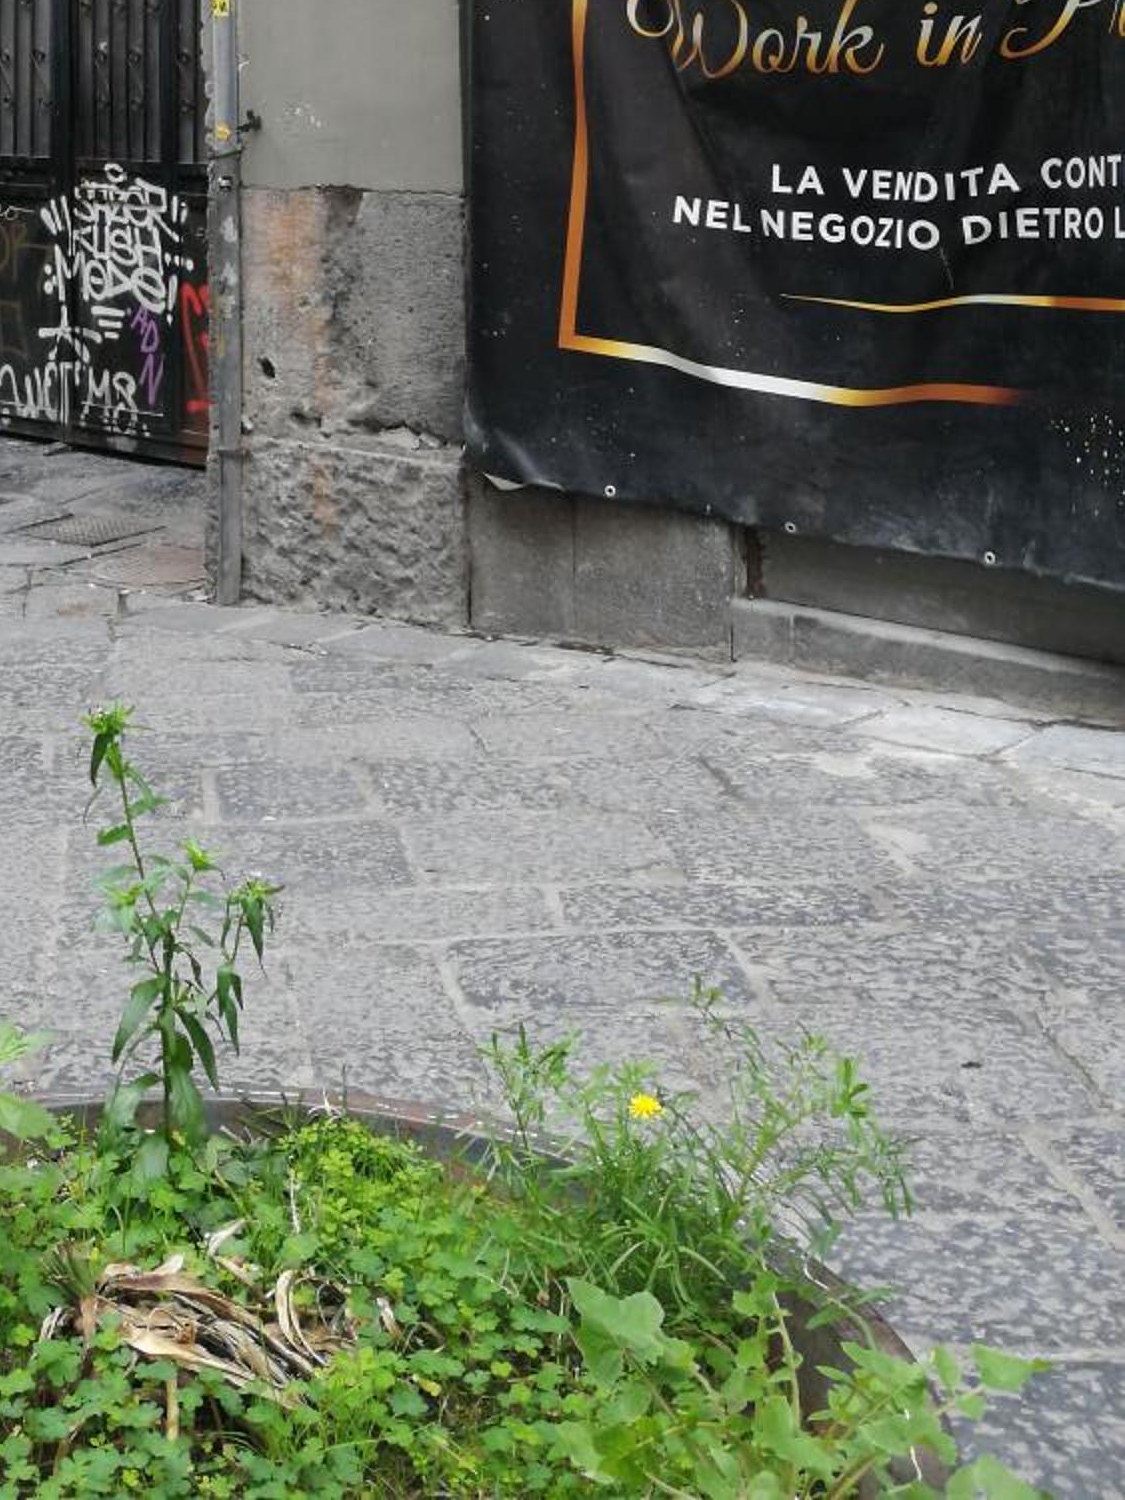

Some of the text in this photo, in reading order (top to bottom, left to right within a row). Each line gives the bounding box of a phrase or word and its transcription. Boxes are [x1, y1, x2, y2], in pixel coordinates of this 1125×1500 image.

[916, 1, 983, 67] in
[771, 164, 824, 196] LA
[842, 163, 1021, 202] VENDITA
[673, 195, 752, 233] NEL
[760, 208, 941, 251] NEGOZIO
[961, 206, 1105, 246] DIETRO
